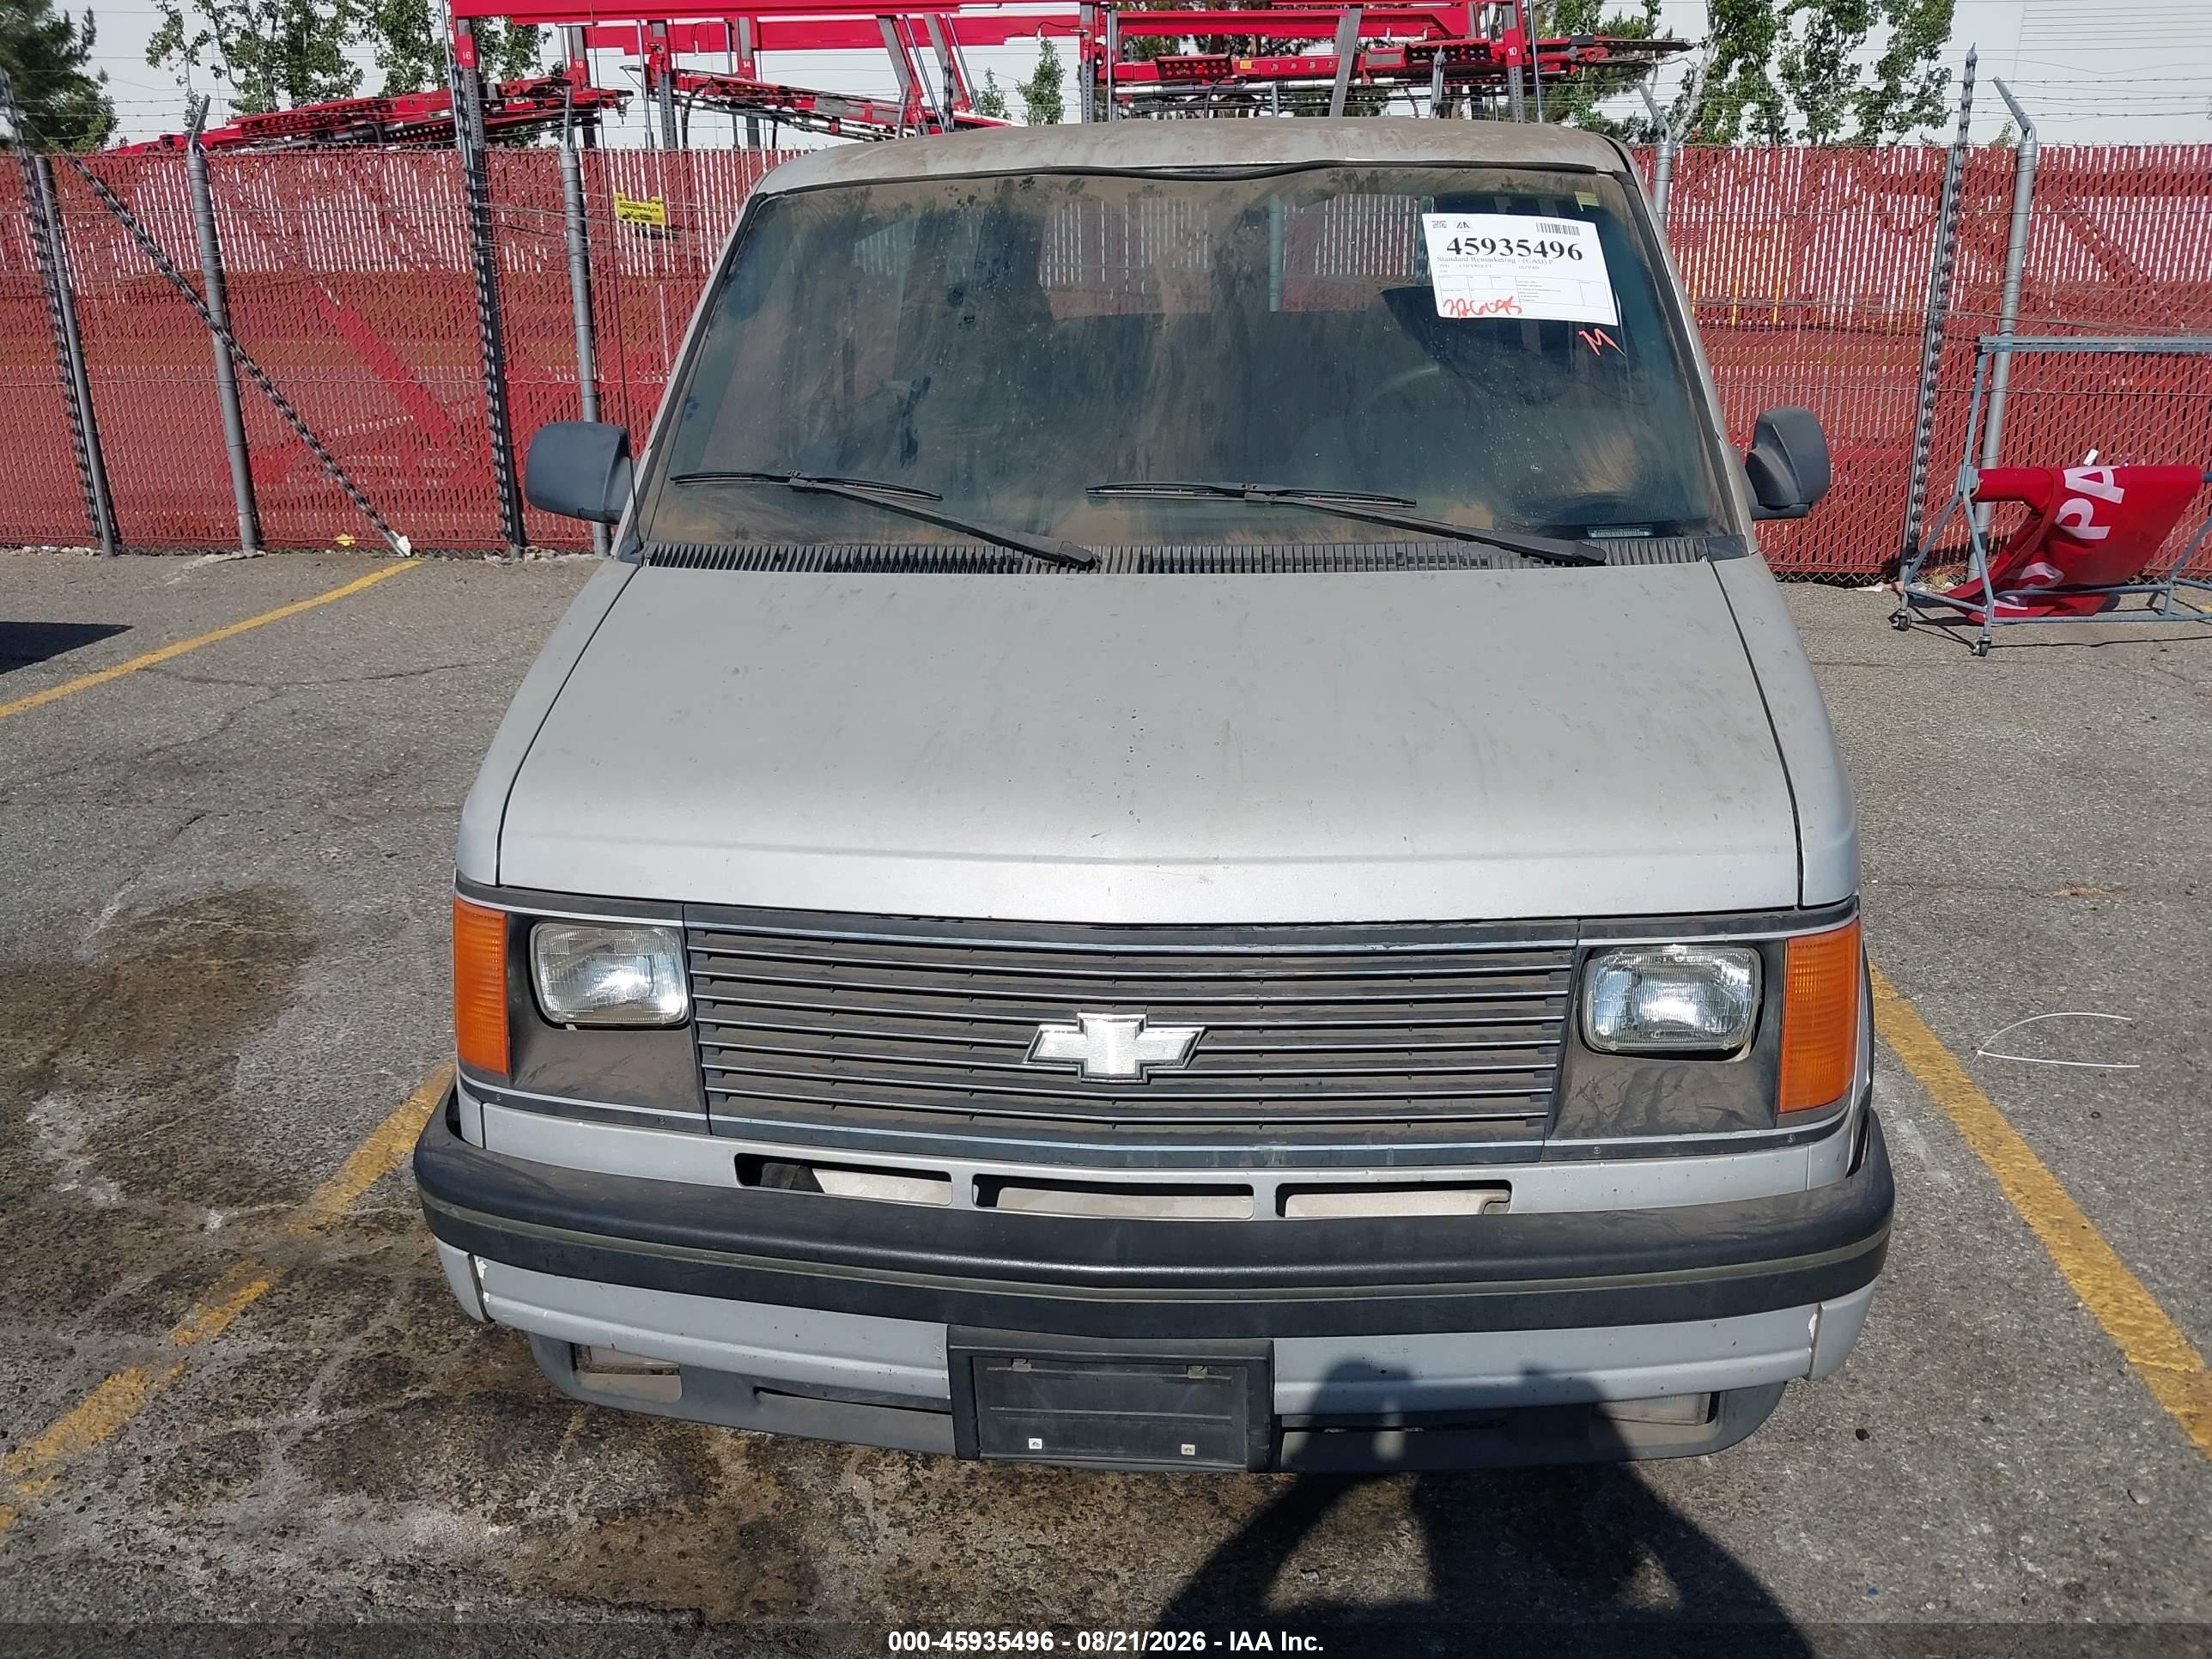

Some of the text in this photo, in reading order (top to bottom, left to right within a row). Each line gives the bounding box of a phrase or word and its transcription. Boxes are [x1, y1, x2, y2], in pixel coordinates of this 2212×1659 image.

[462, 51, 472, 60] 16
[1508, 46, 1517, 56] 10
[1446, 237, 1583, 261] 45935496
[1471, 257, 1516, 265] Remarketing
